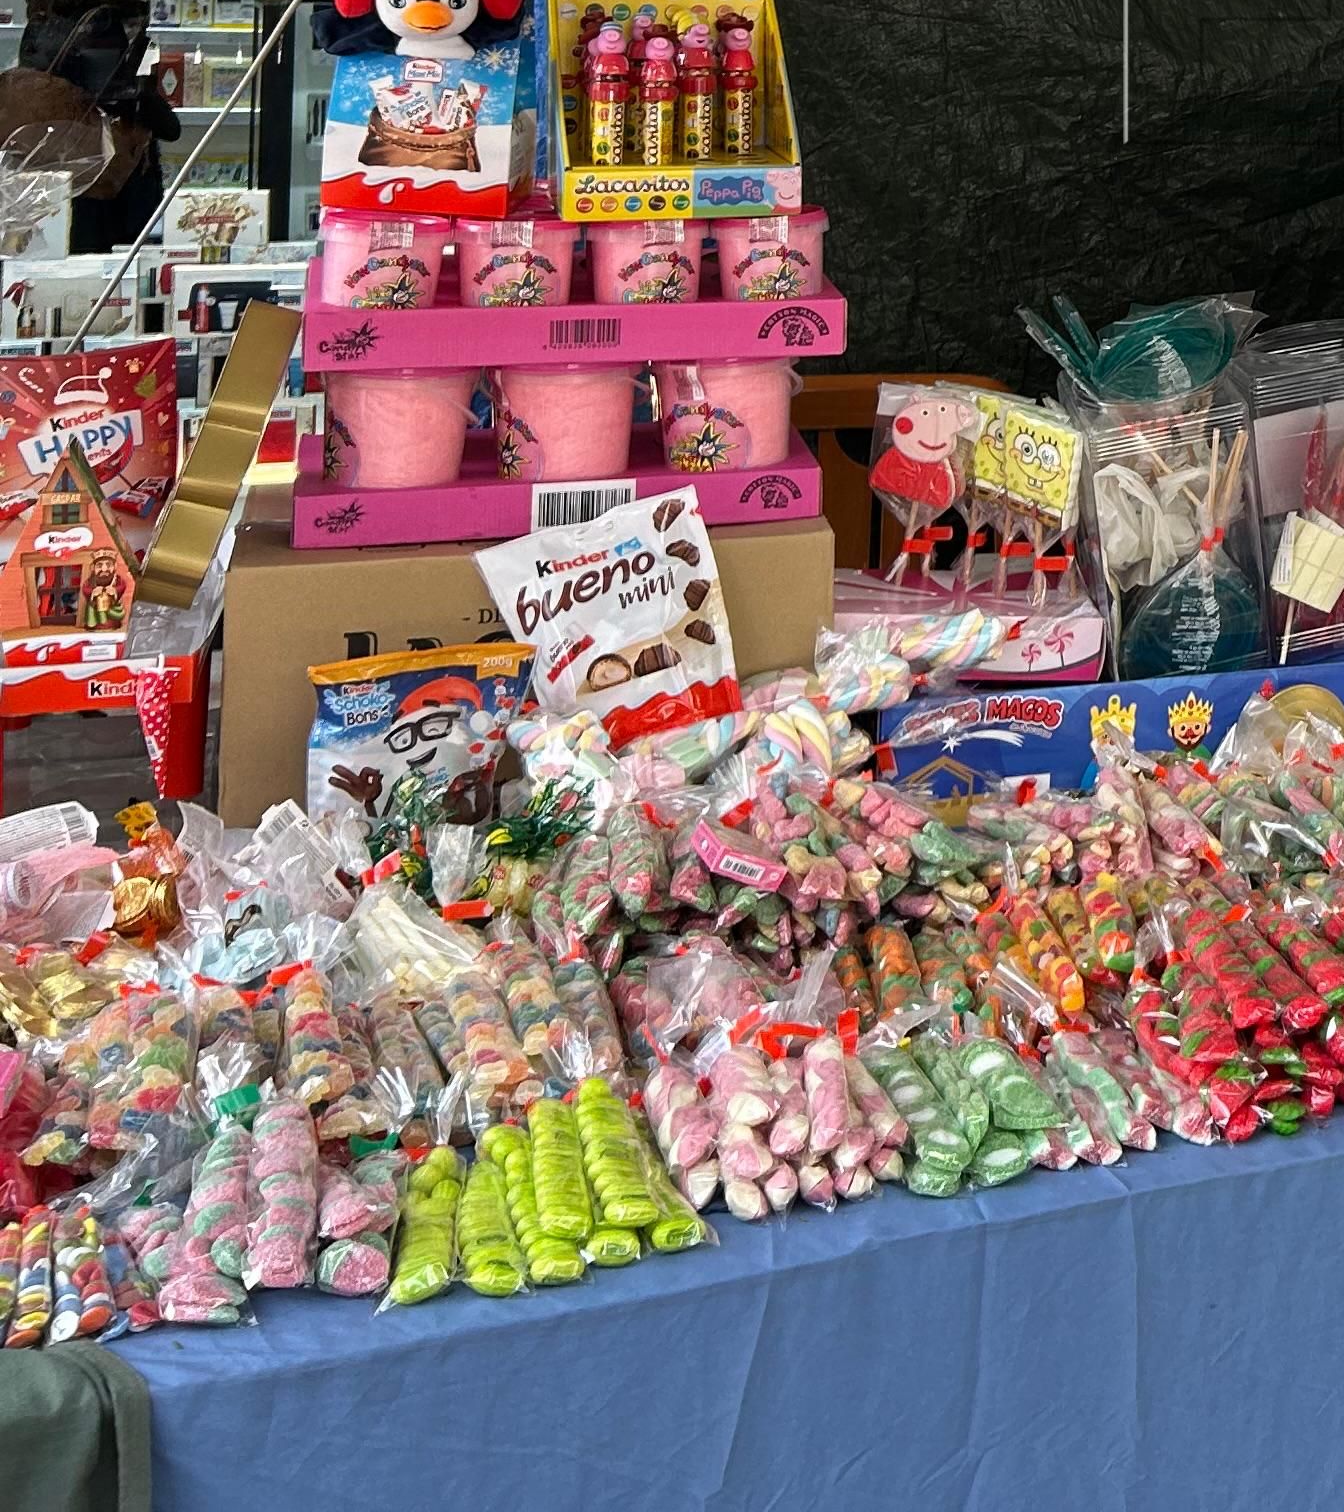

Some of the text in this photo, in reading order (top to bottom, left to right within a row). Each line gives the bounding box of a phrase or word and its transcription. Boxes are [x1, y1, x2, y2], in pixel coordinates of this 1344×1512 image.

[574, 174, 691, 195] Lacasitos
[700, 180, 763, 201] Peppa Pig
[50, 407, 106, 433] Kinder
[535, 548, 610, 579] Kinder
[515, 550, 656, 637] bueno
[618, 565, 676, 610] mini
[89, 680, 138, 698] Kind
[344, 710, 381, 727] Bons
[984, 695, 1064, 730] MAGOS
